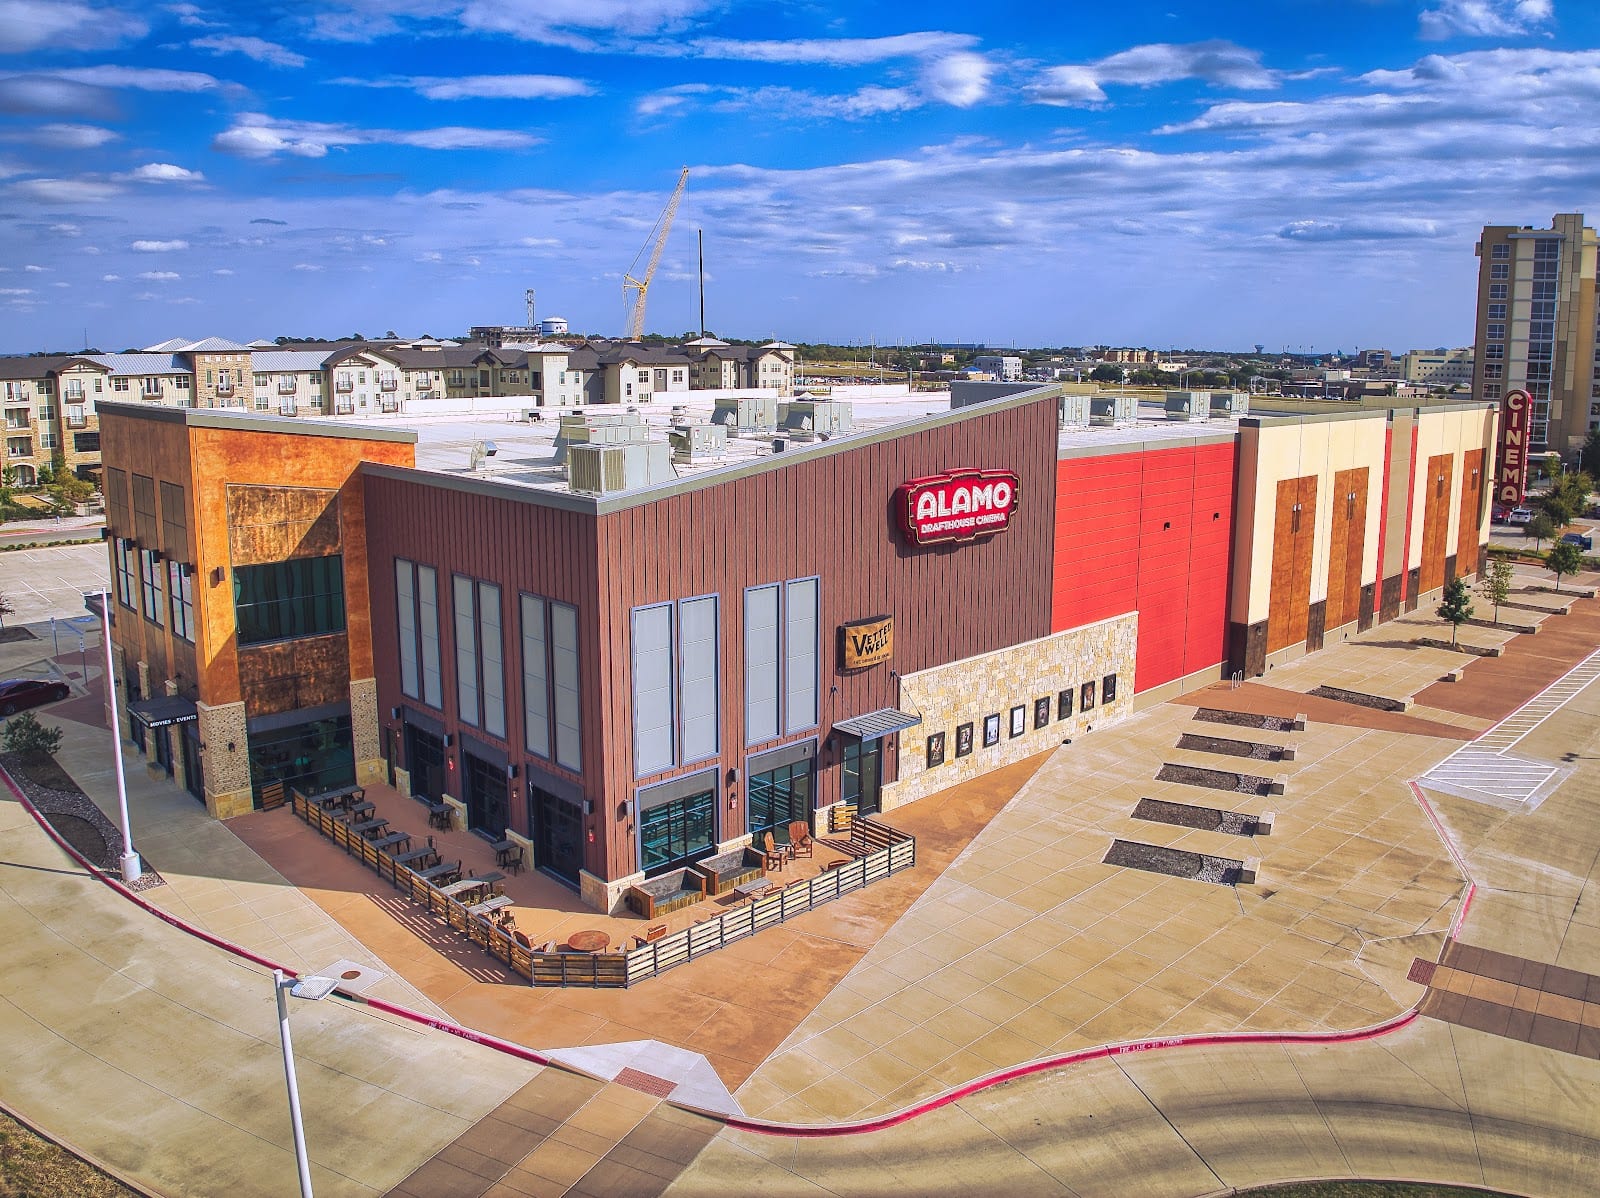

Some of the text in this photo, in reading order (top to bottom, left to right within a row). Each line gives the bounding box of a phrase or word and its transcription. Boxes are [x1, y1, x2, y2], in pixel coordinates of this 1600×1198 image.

[1501, 393, 1522, 501] CINEMA
[917, 482, 1011, 520] ALAMO
[921, 512, 1006, 533] DRAFTHOUSE CINEMA
[852, 622, 892, 657] VETTED
[865, 636, 888, 655] WELL
[150, 714, 197, 727] MOVIES EVENTS
